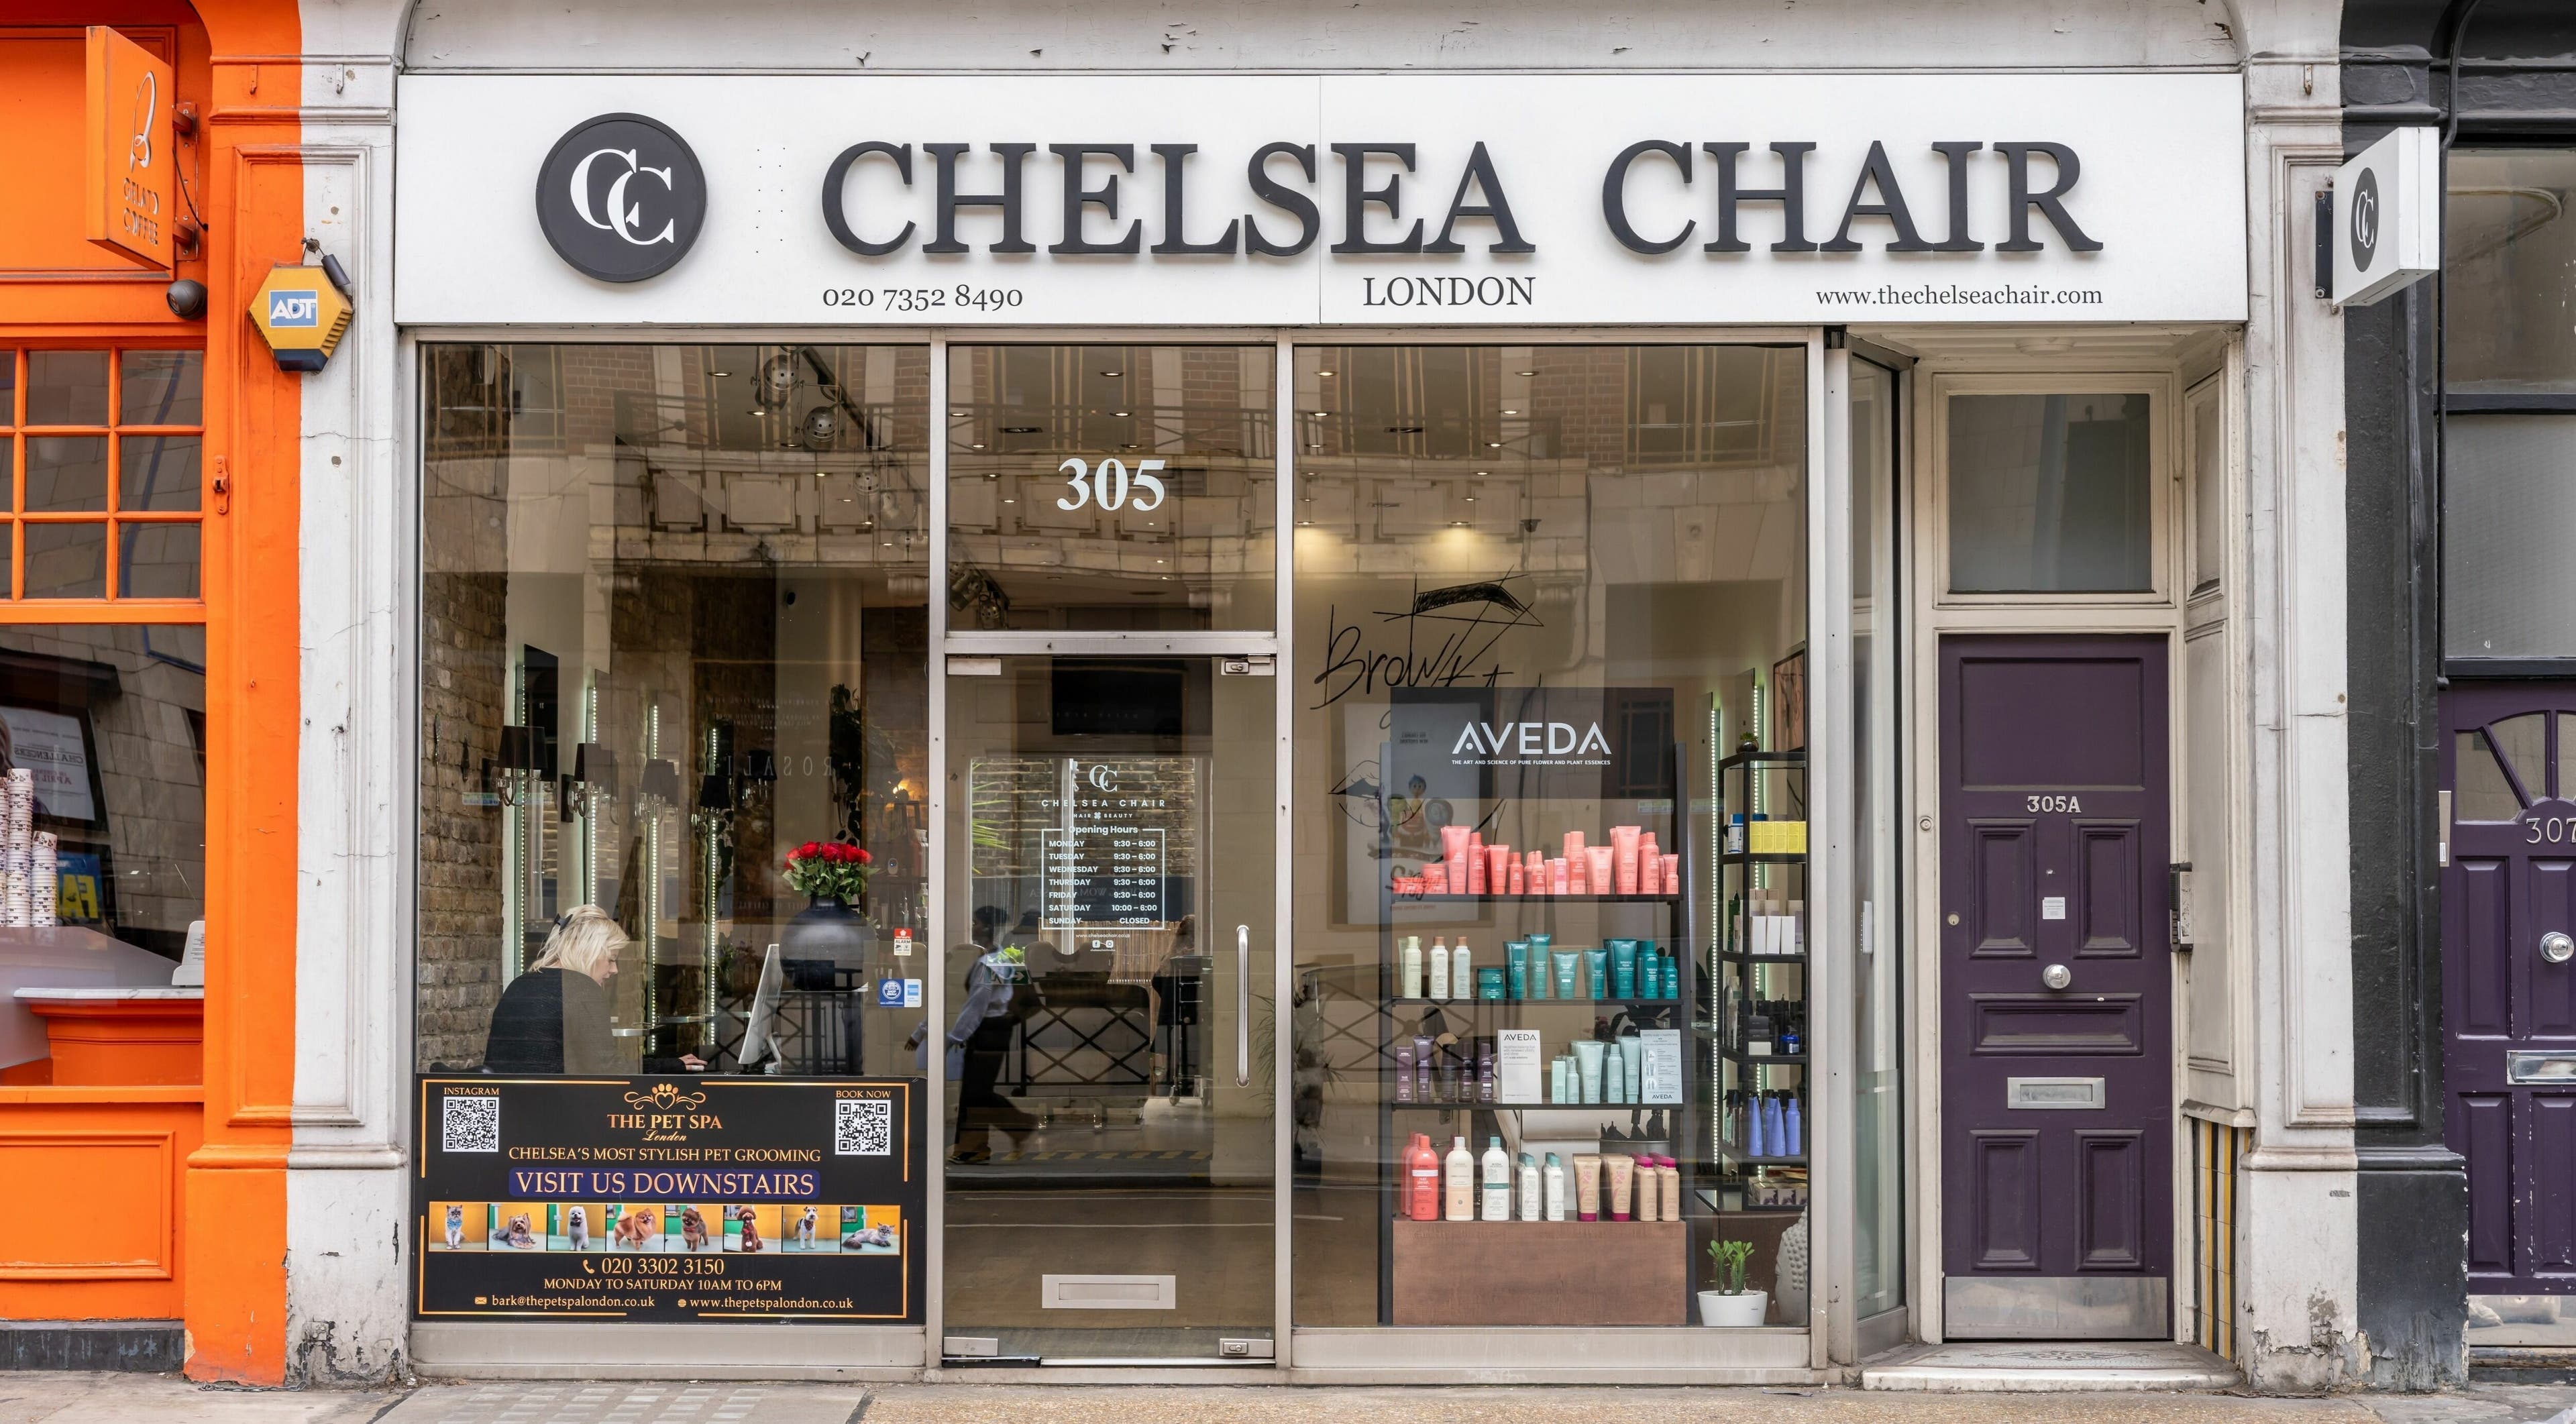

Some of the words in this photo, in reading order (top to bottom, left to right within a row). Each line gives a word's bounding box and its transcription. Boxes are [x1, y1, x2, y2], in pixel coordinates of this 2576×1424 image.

[123, 177, 159, 215] GELATO
[570, 148, 674, 245] CC
[822, 141, 1536, 257] CHELSEA
[1602, 140, 2104, 255] CHAIR
[123, 207, 158, 246] COFFEE
[822, 289, 874, 307] 020
[883, 289, 945, 311] 7352
[955, 284, 1023, 311] 8490
[1362, 276, 1536, 307] LONDON
[1816, 284, 2103, 305] www.thechelseachair.com
[270, 298, 316, 319] ADT
[1057, 457, 1166, 511] 305
[1452, 721, 1612, 755] AVEDA
[1041, 799, 1108, 807] CHELSEA
[1119, 799, 1165, 807] CHAIR
[2027, 796, 2082, 813] 305A
[1068, 825, 1108, 835] Opening
[1110, 826, 1138, 834] Hours
[2526, 817, 2576, 844] 307
[443, 1087, 500, 1095] INSTAGRAM
[836, 1090, 864, 1099] BOOK
[866, 1090, 891, 1099] NOW
[606, 1114, 645, 1129] THE
[651, 1114, 686, 1129] PET
[689, 1114, 723, 1130] SPA
[641, 1129, 687, 1142] London
[508, 1147, 590, 1160] CHELSEA'S
[594, 1148, 636, 1160] MOST
[639, 1148, 700, 1161] STYLISH
[704, 1148, 731, 1161] PET
[735, 1148, 821, 1162] GROOMING
[515, 1172, 584, 1193] VISIT
[592, 1172, 625, 1194] US
[633, 1172, 814, 1195] DOWNSTAIRS
[601, 1258, 633, 1274] 020
[637, 1258, 678, 1274] 3302
[684, 1258, 724, 1275] 3150
[544, 1278, 602, 1290] MONDAY
[605, 1278, 624, 1290] TO
[626, 1278, 694, 1291] SATURDAY
[698, 1279, 732, 1291] 10AM
[735, 1279, 753, 1291] TO
[756, 1279, 782, 1291] 6PM
[492, 1295, 655, 1310] bark@thepetspalondon.co.uk
[690, 1296, 853, 1312] www.thepetspalondon.co.uk
